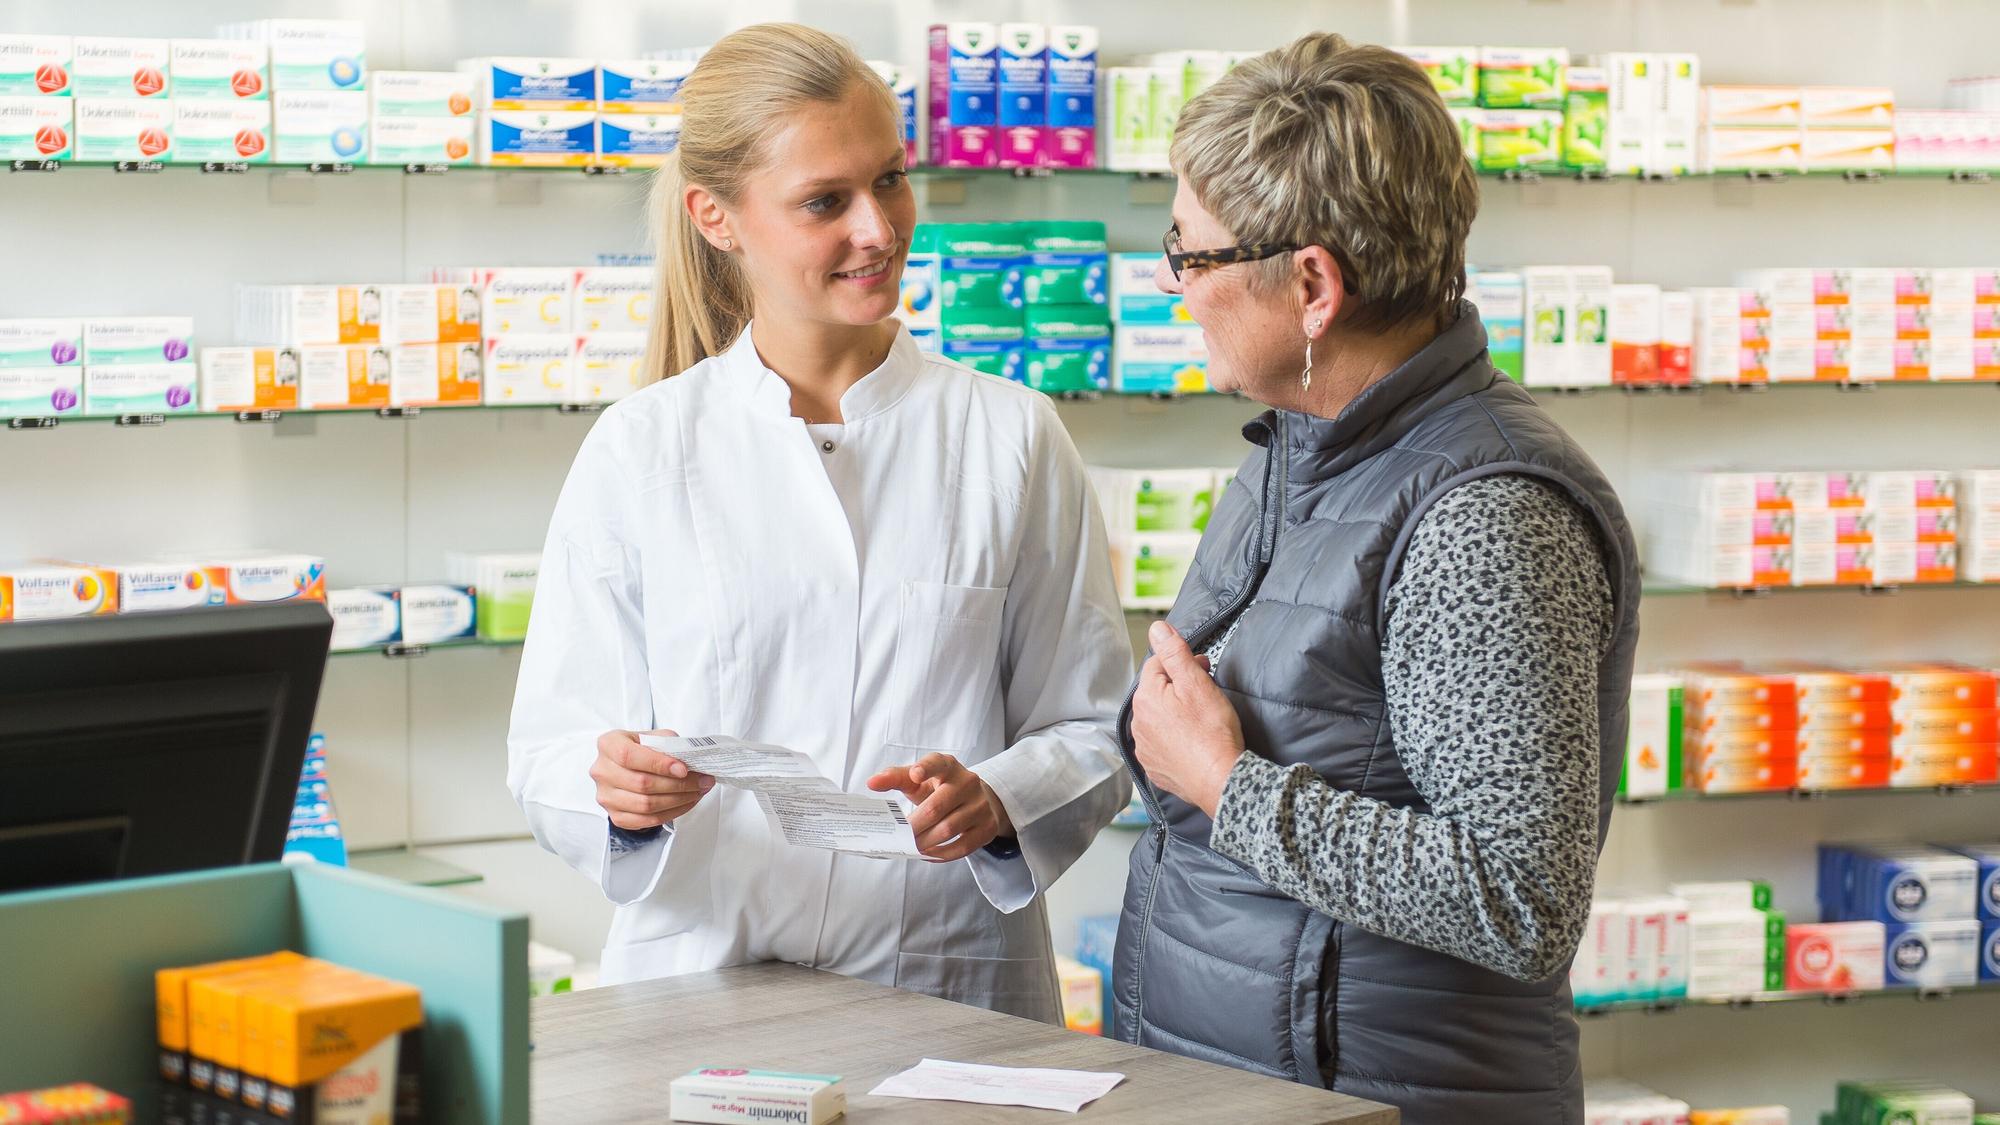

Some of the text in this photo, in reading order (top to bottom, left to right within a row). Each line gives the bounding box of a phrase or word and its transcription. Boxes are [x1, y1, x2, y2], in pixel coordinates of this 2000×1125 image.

[77, 44, 132, 58] Dolormin
[175, 46, 230, 60] Dolormin
[492, 280, 567, 326] Grippostad C
[90, 323, 134, 336] Dolormin
[495, 345, 569, 390] Grippostad C
[91, 370, 136, 383] Dolormin
[17, 576, 71, 590] Voltaren
[129, 571, 182, 584] Voltaren
[712, 1102, 808, 1124] Dolormin Migräne
